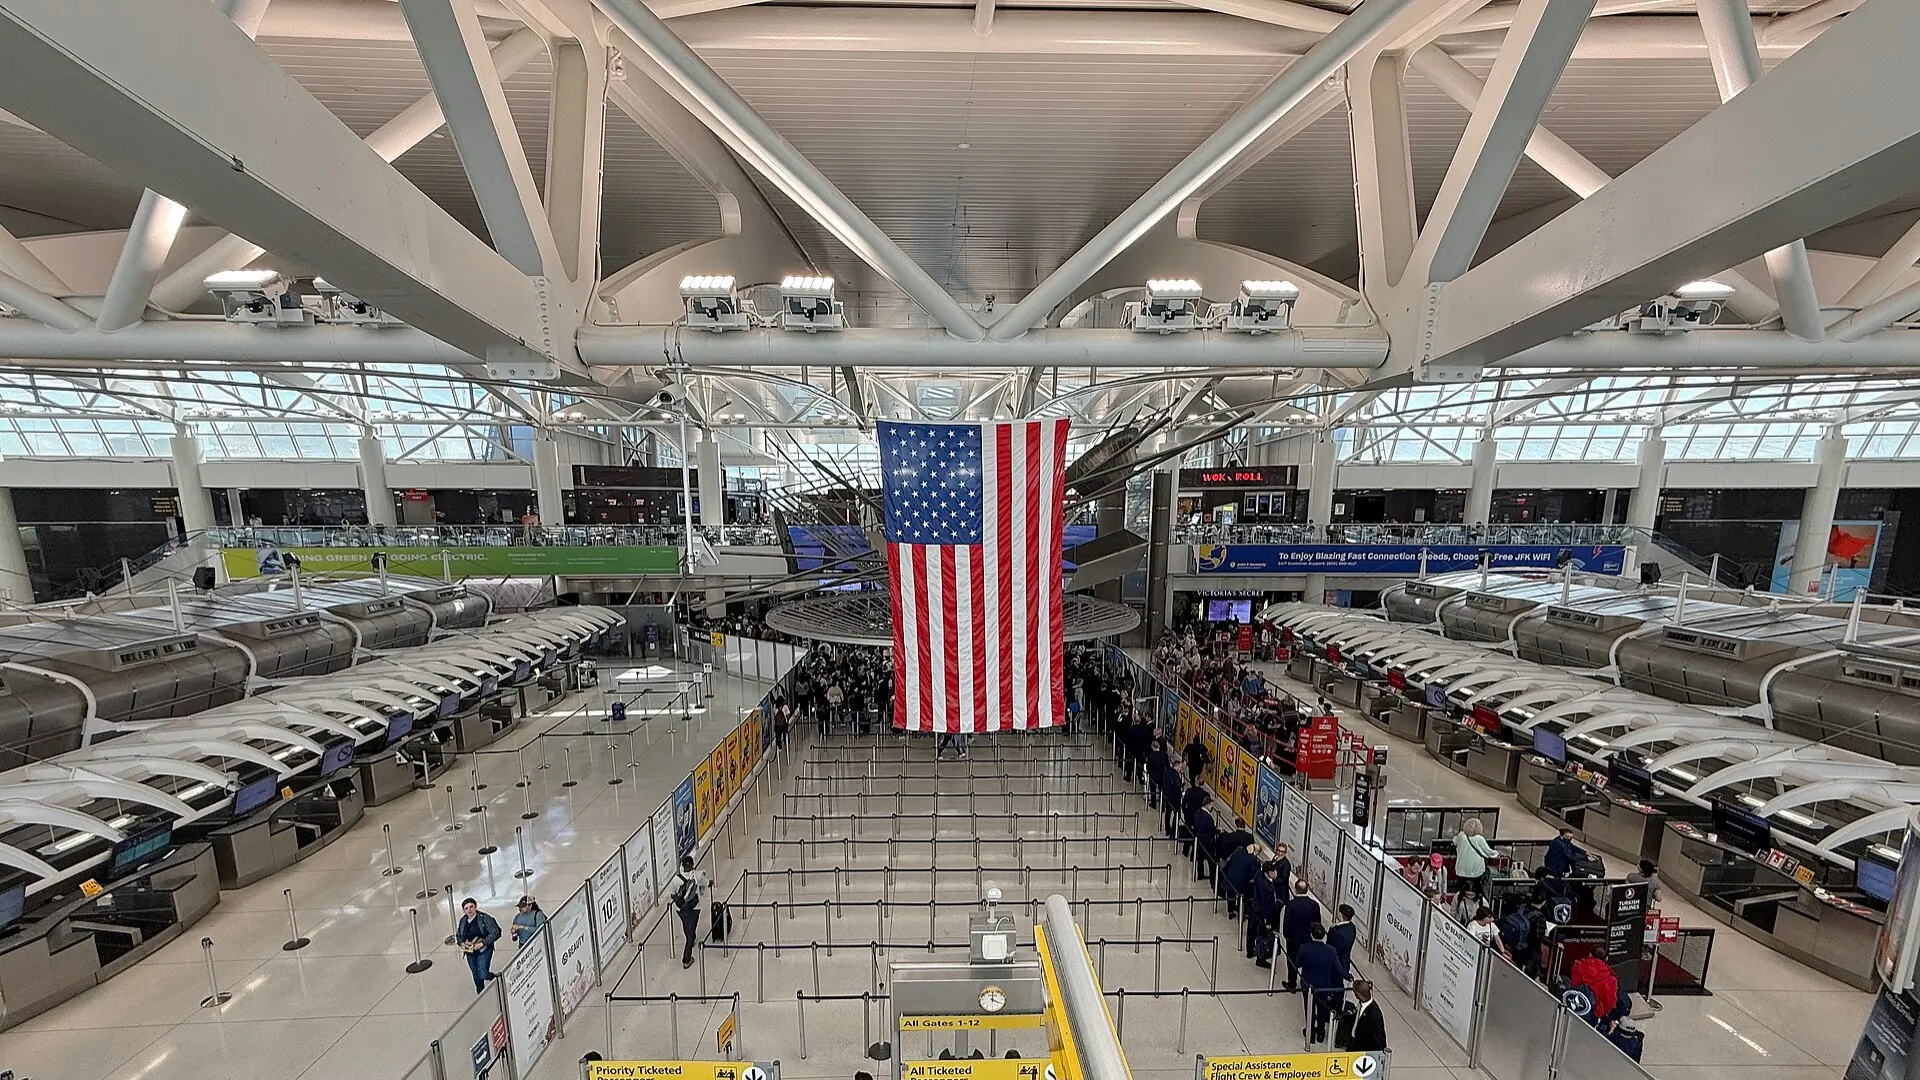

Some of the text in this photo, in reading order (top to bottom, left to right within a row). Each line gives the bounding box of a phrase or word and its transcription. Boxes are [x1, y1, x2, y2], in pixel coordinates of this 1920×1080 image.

[1290, 553, 1314, 561] Enjoy
[1316, 552, 1346, 561] Blazing
[1368, 552, 1416, 560] Connection
[1318, 850, 1332, 867] BEAUTY
[636, 861, 648, 879] BEAUTY
[1393, 918, 1413, 942] BEAUTY
[1450, 927, 1466, 943] BEAUTY
[568, 933, 585, 958] BEAUTY
[520, 946, 534, 965] BEAUTY
[597, 1066, 682, 1076] Priority Ticketed
[910, 1066, 971, 1075] All Ticketed
[1211, 1061, 1292, 1072] Special Assistance
[1264, 1071, 1271, 1079] &
[1274, 1070, 1321, 1080] Employees
